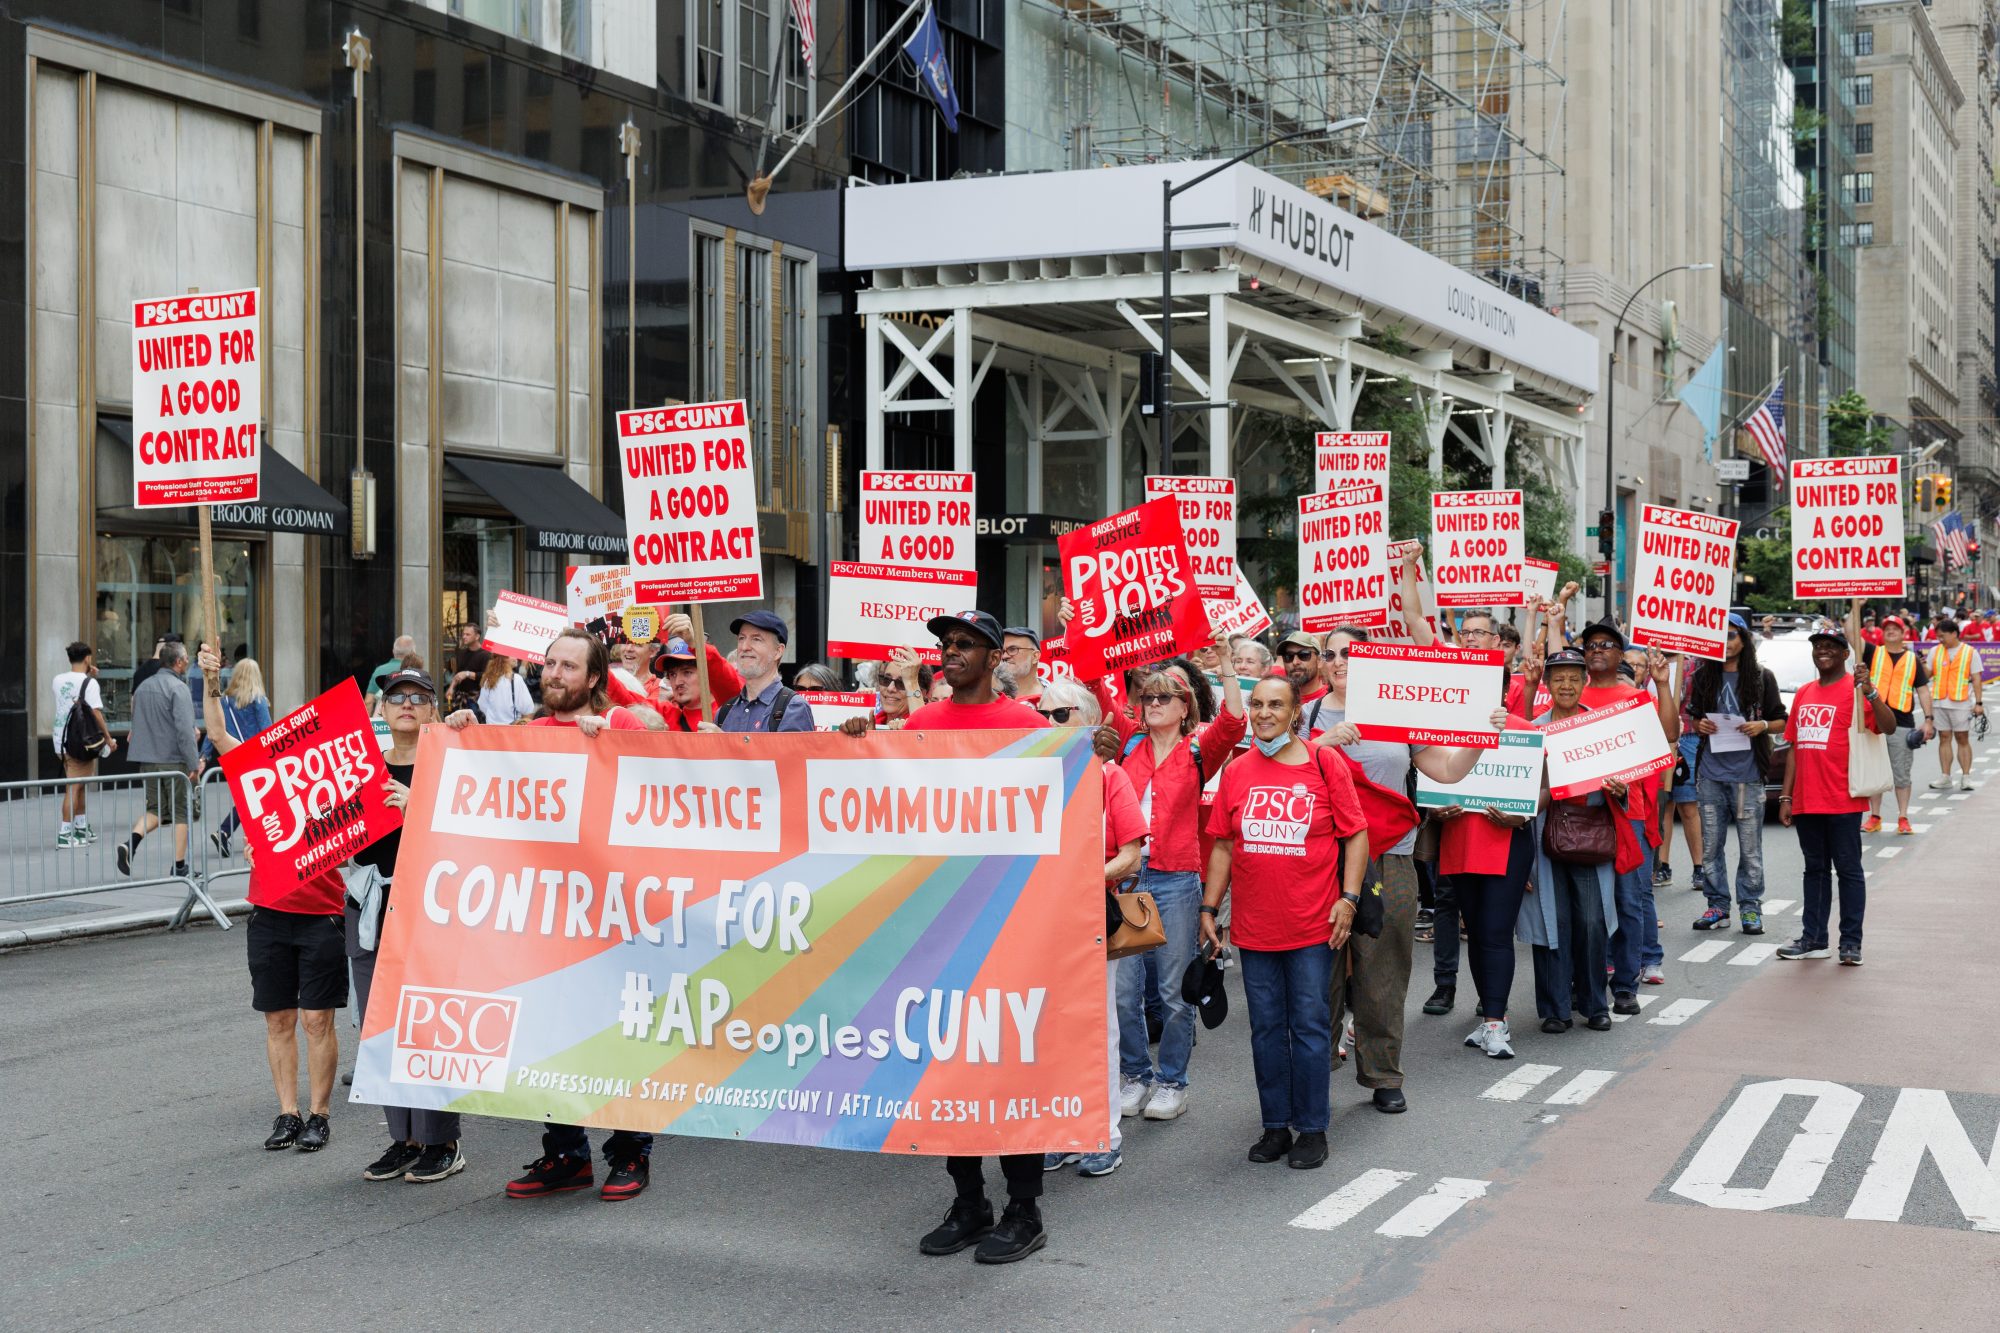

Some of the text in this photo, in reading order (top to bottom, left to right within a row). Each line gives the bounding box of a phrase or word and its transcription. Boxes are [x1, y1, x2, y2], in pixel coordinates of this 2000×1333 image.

[1271, 195, 1355, 272] HUBLOT
[142, 294, 248, 325] PSC-CUNY
[1447, 284, 1515, 339] LOUIS VUITTON
[138, 328, 255, 373] UNITED FOR
[160, 379, 241, 417] A GOOD
[629, 406, 736, 434] PSC-CUNY
[139, 424, 257, 465] CONTRACT
[1323, 434, 1384, 446] PSC-CUNY
[626, 438, 747, 479] UNITED FOR
[1319, 453, 1386, 471] UNITED FOR
[1800, 457, 1891, 477] PSC-CUNY
[145, 483, 188, 491] Professional
[203, 479, 236, 488] Congress
[239, 477, 254, 485] CUNY
[163, 490, 178, 498] AFT
[179, 489, 195, 497] Local
[195, 488, 212, 496] 2334
[219, 487, 232, 495] AFL
[870, 474, 966, 491] PSC-CUNY
[1153, 478, 1229, 493] PSC-CUNY
[1796, 482, 1898, 508] UNITED FOR
[649, 484, 730, 521] A GOOD
[1206, 500, 1233, 521] FOR
[1305, 487, 1378, 513] PSC-CUNY
[1440, 492, 1515, 507] PSC-CUNY
[209, 504, 334, 530] ERGDORF GOODMAN
[865, 500, 971, 527] UNITED FOR
[976, 518, 1028, 535] BLOT
[1091, 510, 1141, 538] RAISES, EQUITY,
[1302, 510, 1383, 544] UNITED FOR
[1436, 511, 1520, 533] UNITED FOR
[1650, 509, 1731, 536] PSC-CUNY
[1813, 514, 1883, 538] A GOOD
[539, 531, 586, 549] BERGDORF
[633, 527, 754, 566] CONTRACT
[881, 535, 955, 561] A GOOD
[1094, 521, 1141, 550] JUSTICE
[1450, 538, 1508, 558] A GOOD
[1313, 551, 1324, 574] A
[1326, 544, 1370, 571] GOOD
[1643, 531, 1731, 569] UNITED FOR
[1797, 545, 1901, 570] CONTRACT
[600, 578, 622, 592] FOR THE
[641, 577, 753, 590] Professional Staff Congress CUNY
[833, 563, 964, 582] PSC/CUNY Members Want
[1070, 545, 1179, 601] PROTECT
[1437, 564, 1522, 584] CONTRACT
[1653, 565, 1715, 597] A GOOD
[501, 591, 540, 607] PSC/CUNY
[584, 587, 633, 608] NEW YORK HEALTH
[657, 589, 670, 597] AFT
[671, 588, 686, 596] Local
[724, 585, 737, 593] CIO
[1084, 567, 1186, 638] JOBS
[1302, 574, 1385, 607] CONTRACT
[860, 602, 945, 623] RESPECT
[1080, 598, 1096, 625] OUR
[1636, 593, 1727, 631] CONTRACT
[513, 620, 559, 641] RESPE
[1103, 629, 1174, 659] CONTRACT FOR
[1351, 644, 1489, 663] PSC/CUNY Members Want
[841, 695, 865, 704] Want
[1377, 683, 1470, 705] RESPECT
[1573, 697, 1639, 726] Members Want
[1797, 706, 1833, 728] PSC
[260, 705, 319, 749] RAISES, EQUITY,
[268, 717, 322, 760] JUSTICE
[1408, 730, 1497, 746] #APeoplesCUNY
[1508, 735, 1530, 744] Want
[1562, 730, 1637, 764] RESPECT
[239, 729, 367, 819] PROTECT
[1468, 762, 1533, 779] CURITY
[272, 751, 375, 853] JOBS
[450, 774, 1050, 834] RAISES JUSTICE COMMUNITY
[1244, 790, 1311, 823] PSC
[262, 811, 284, 842] OUR
[1248, 822, 1301, 840] CUNY
[294, 820, 367, 870] CONTRACT FOR
[423, 859, 812, 952] CONTRACT FOR
[399, 994, 511, 1053] PSC
[618, 971, 1047, 1067] #APeoplesCUNY
[406, 1053, 494, 1085] CUNY
[839, 1092, 872, 1118] AFT
[931, 1099, 981, 1123] 2334
[1004, 1095, 1083, 1121] AFL-CIO
